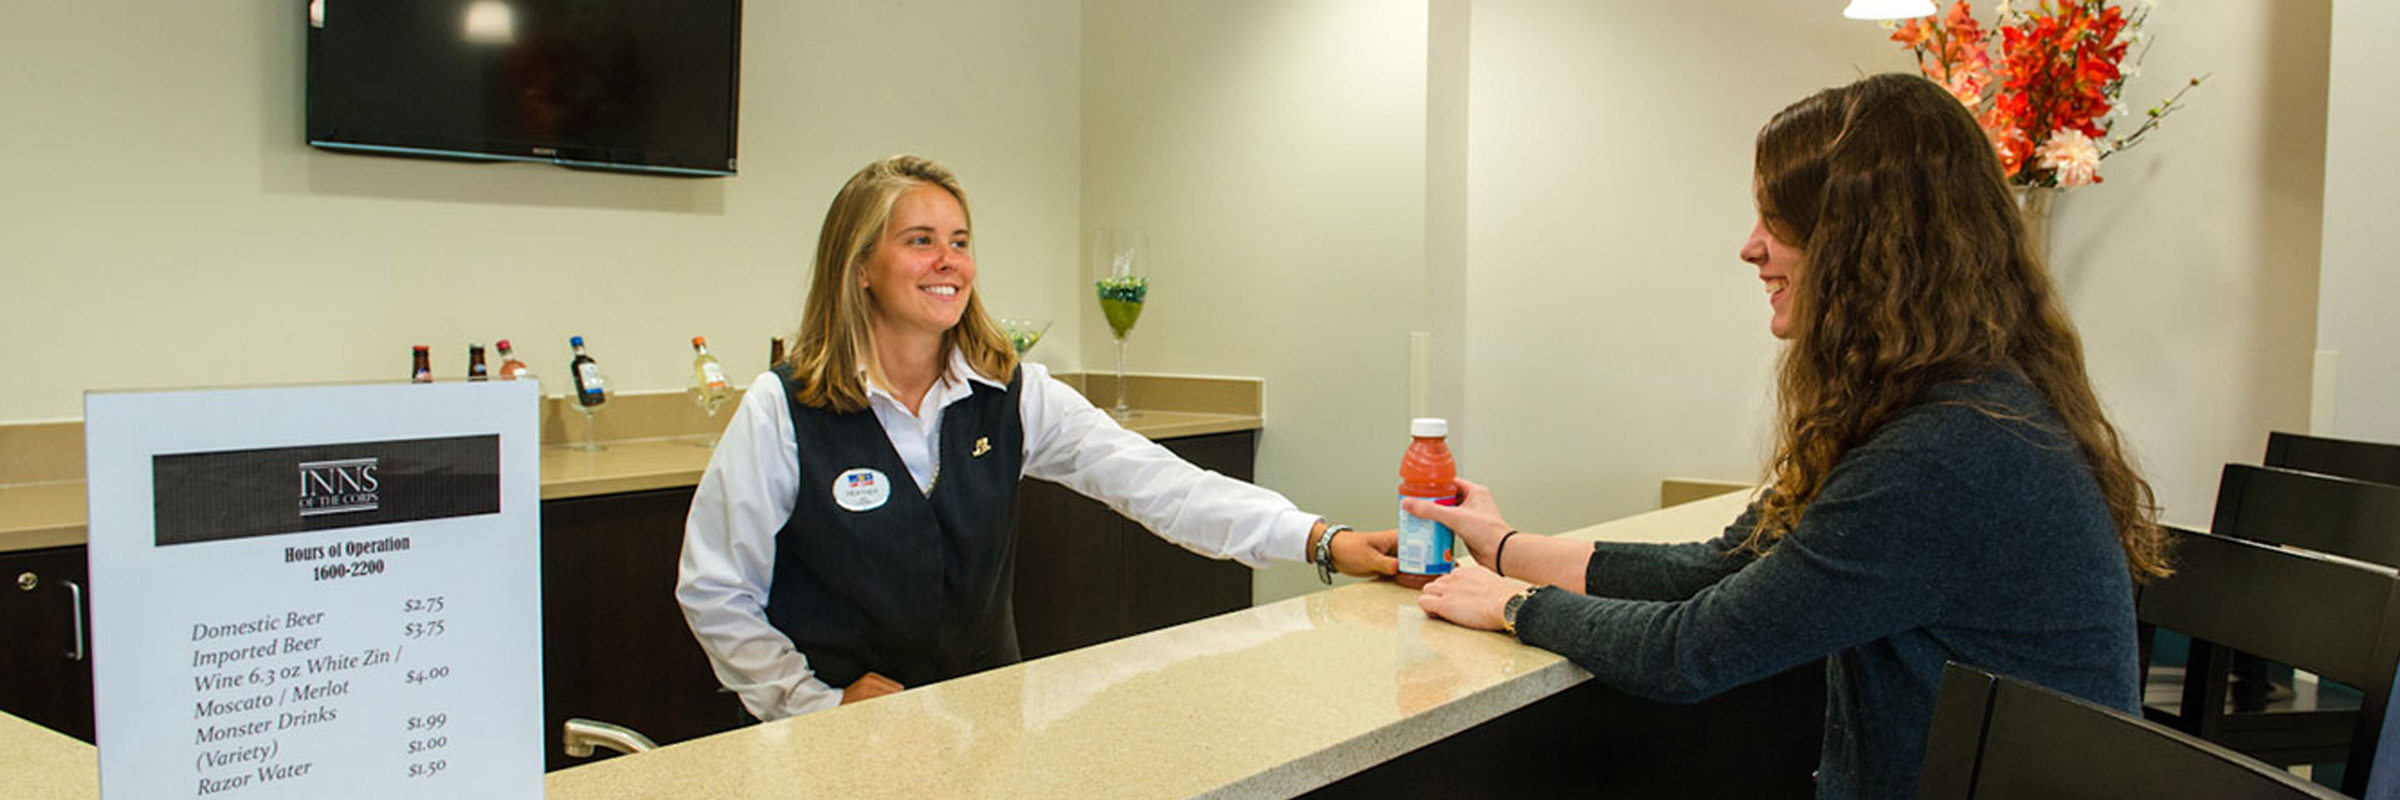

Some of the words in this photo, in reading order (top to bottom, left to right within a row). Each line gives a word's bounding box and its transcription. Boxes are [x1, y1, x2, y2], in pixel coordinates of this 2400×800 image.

[300, 464, 379, 498] INNS
[299, 496, 314, 507] OF
[319, 495, 340, 506] THE
[343, 492, 379, 504] CORPS
[284, 546, 325, 563] Hours
[329, 543, 342, 558] of
[346, 536, 410, 557] Operation
[313, 560, 384, 581] 1600-2200
[404, 596, 444, 612] $2.75
[192, 615, 281, 641] Domestic
[285, 611, 325, 628] Beer
[404, 620, 445, 638] $3.75
[192, 640, 277, 668] Imported
[283, 635, 321, 654] Beer
[195, 672, 244, 692] Wine
[248, 669, 276, 685] 6.3
[281, 665, 300, 679] oz
[307, 654, 359, 675] White
[363, 649, 390, 666] Zin
[395, 646, 403, 663] /
[405, 666, 449, 684] $4.00
[195, 692, 273, 719] Moscato
[279, 690, 286, 706] /
[292, 680, 349, 703] Merlot
[196, 719, 272, 745] Monster
[278, 705, 337, 730] Drinks
[407, 714, 446, 731] $1.99
[196, 739, 279, 772] (Variety)
[408, 737, 447, 754] $1.00
[198, 774, 252, 796] Razor
[257, 761, 312, 785] Water
[408, 760, 446, 778] $1.50
